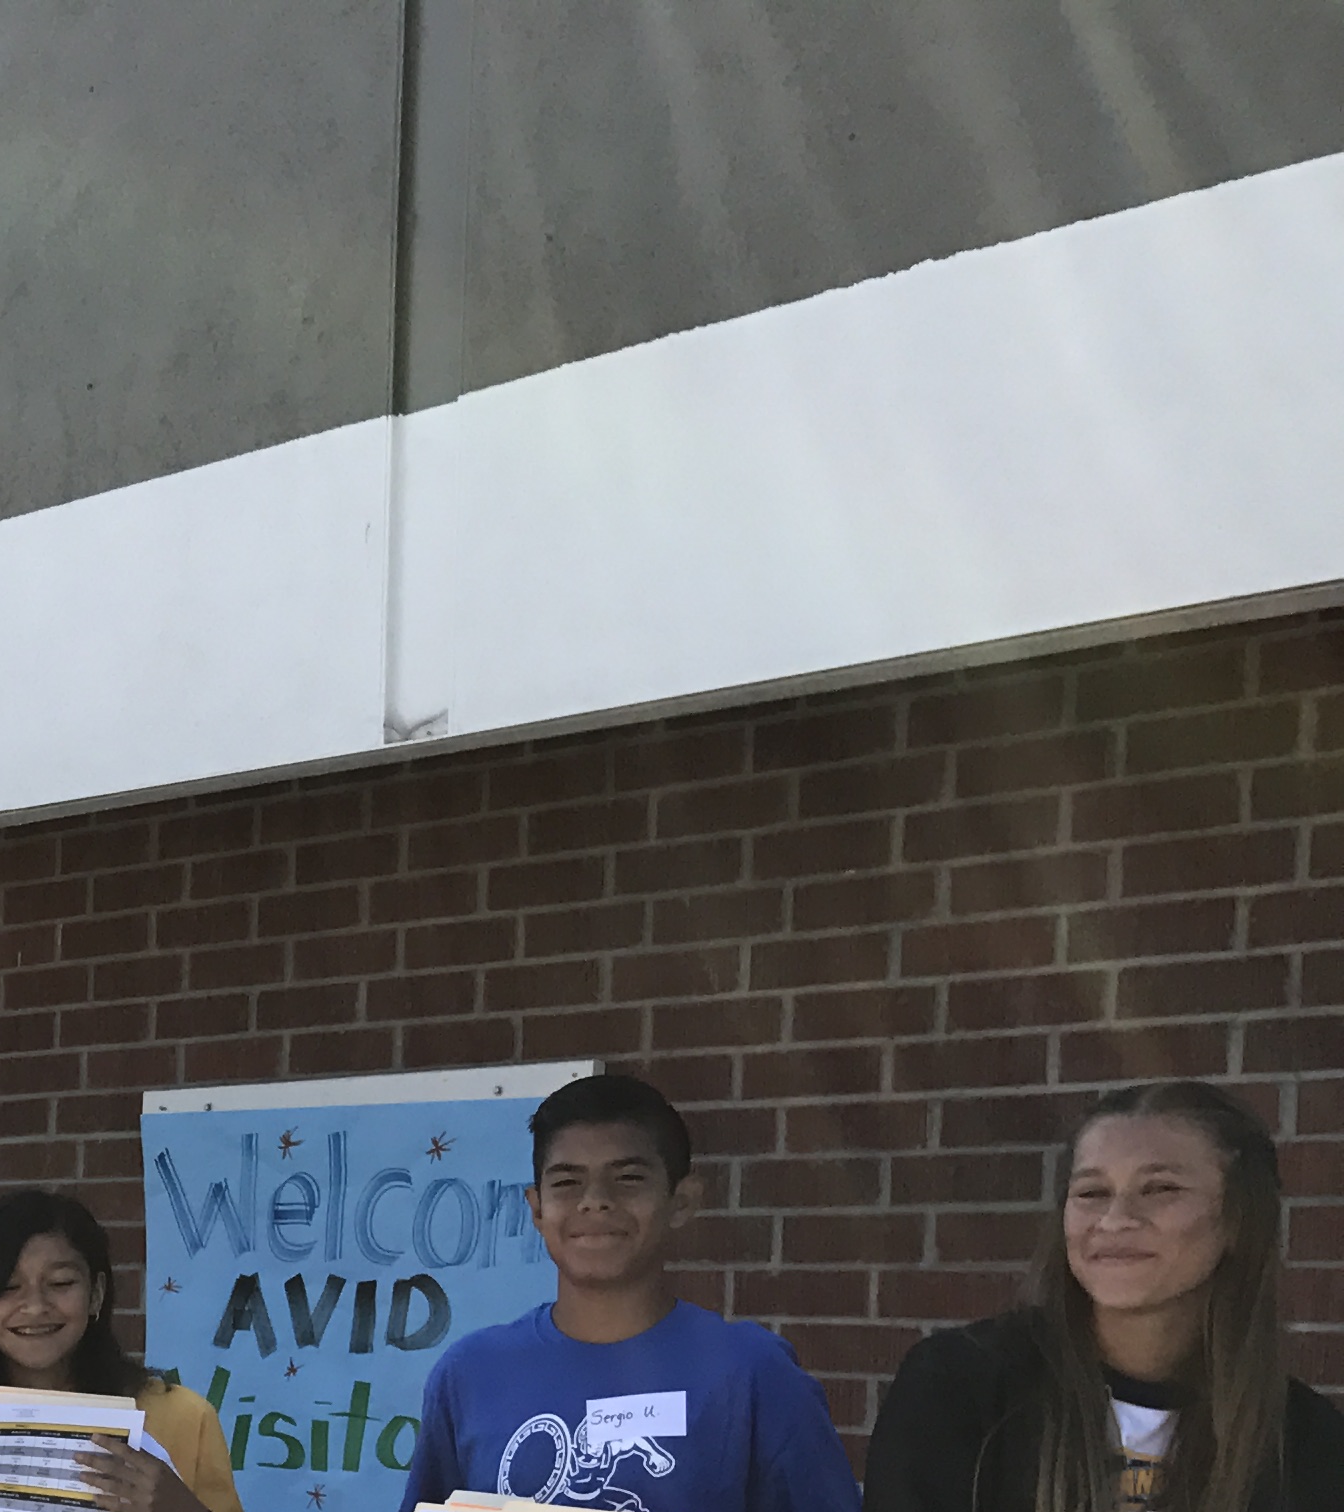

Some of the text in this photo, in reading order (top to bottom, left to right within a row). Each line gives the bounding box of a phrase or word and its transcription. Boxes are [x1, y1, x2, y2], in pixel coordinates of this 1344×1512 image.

[154, 1130, 550, 1270] Welcom
[212, 1272, 452, 1359] AVID
[165, 1366, 422, 1473] isito
[591, 1409, 634, 1428] Sergio
